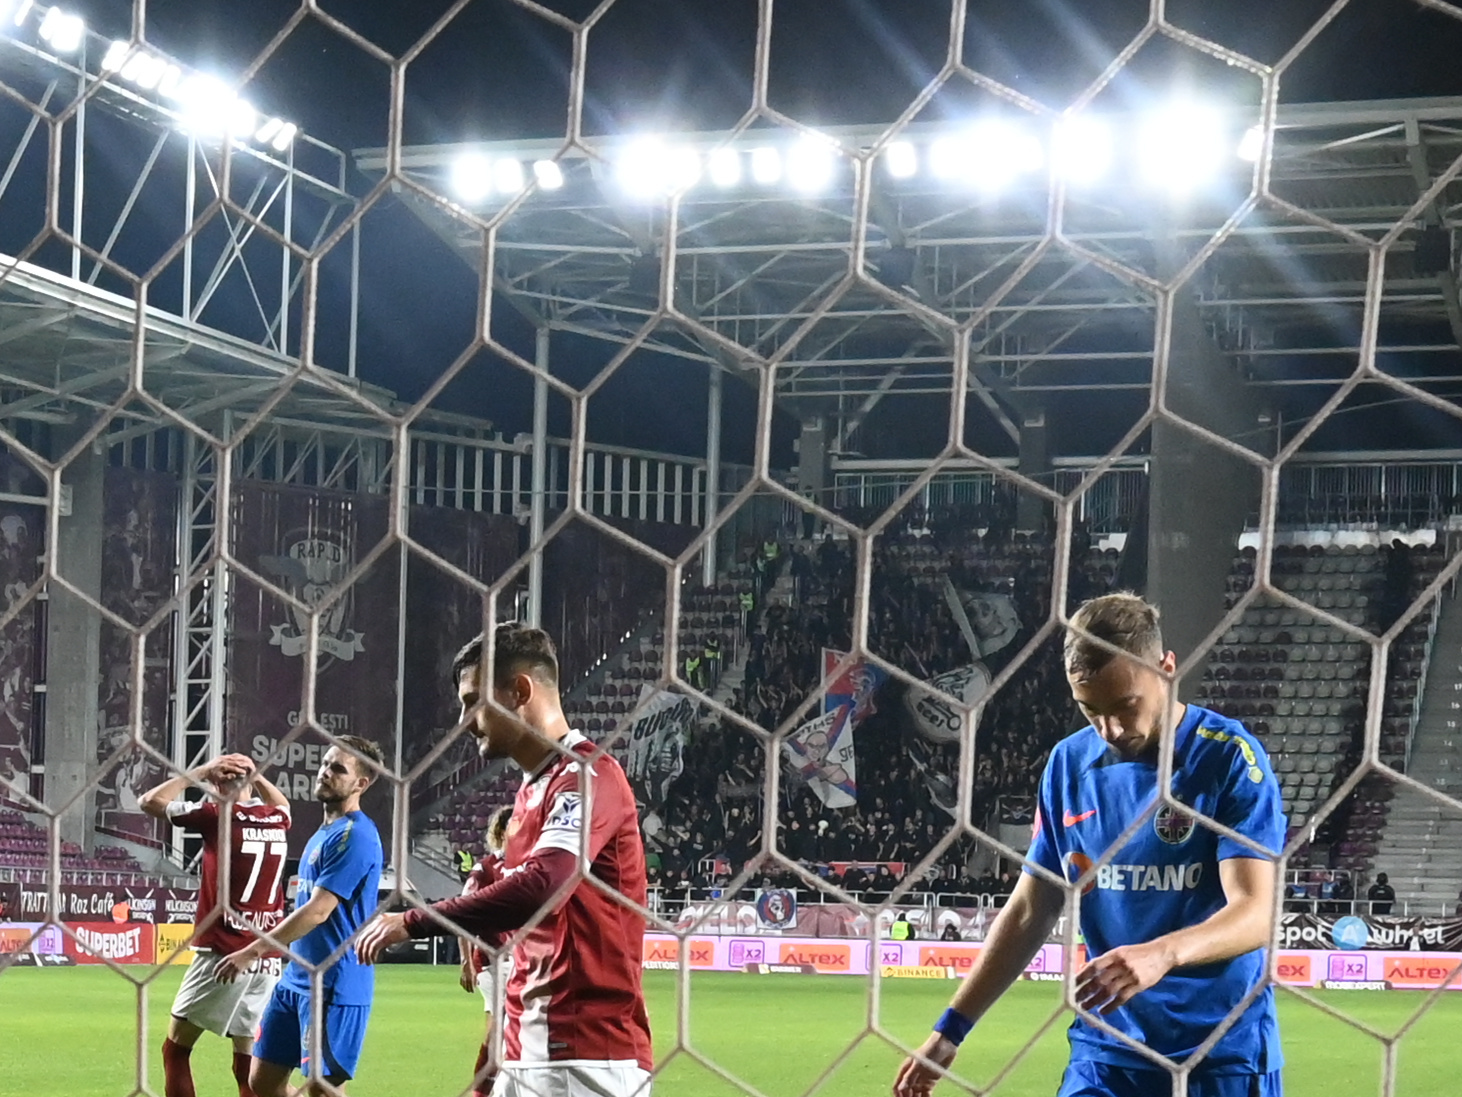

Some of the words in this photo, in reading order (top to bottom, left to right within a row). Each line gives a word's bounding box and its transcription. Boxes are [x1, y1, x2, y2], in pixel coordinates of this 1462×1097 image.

[297, 541, 340, 563] RAPD
[241, 841, 288, 904] 77
[1097, 862, 1204, 891] BETANO
[71, 893, 88, 914] Roz
[91, 892, 114, 916] Café
[76, 927, 141, 955] SUPERBET
[745, 949, 761, 959] X2
[882, 953, 899, 962] X2
[897, 969, 942, 977] BINANCE
[1347, 963, 1363, 973] X2
